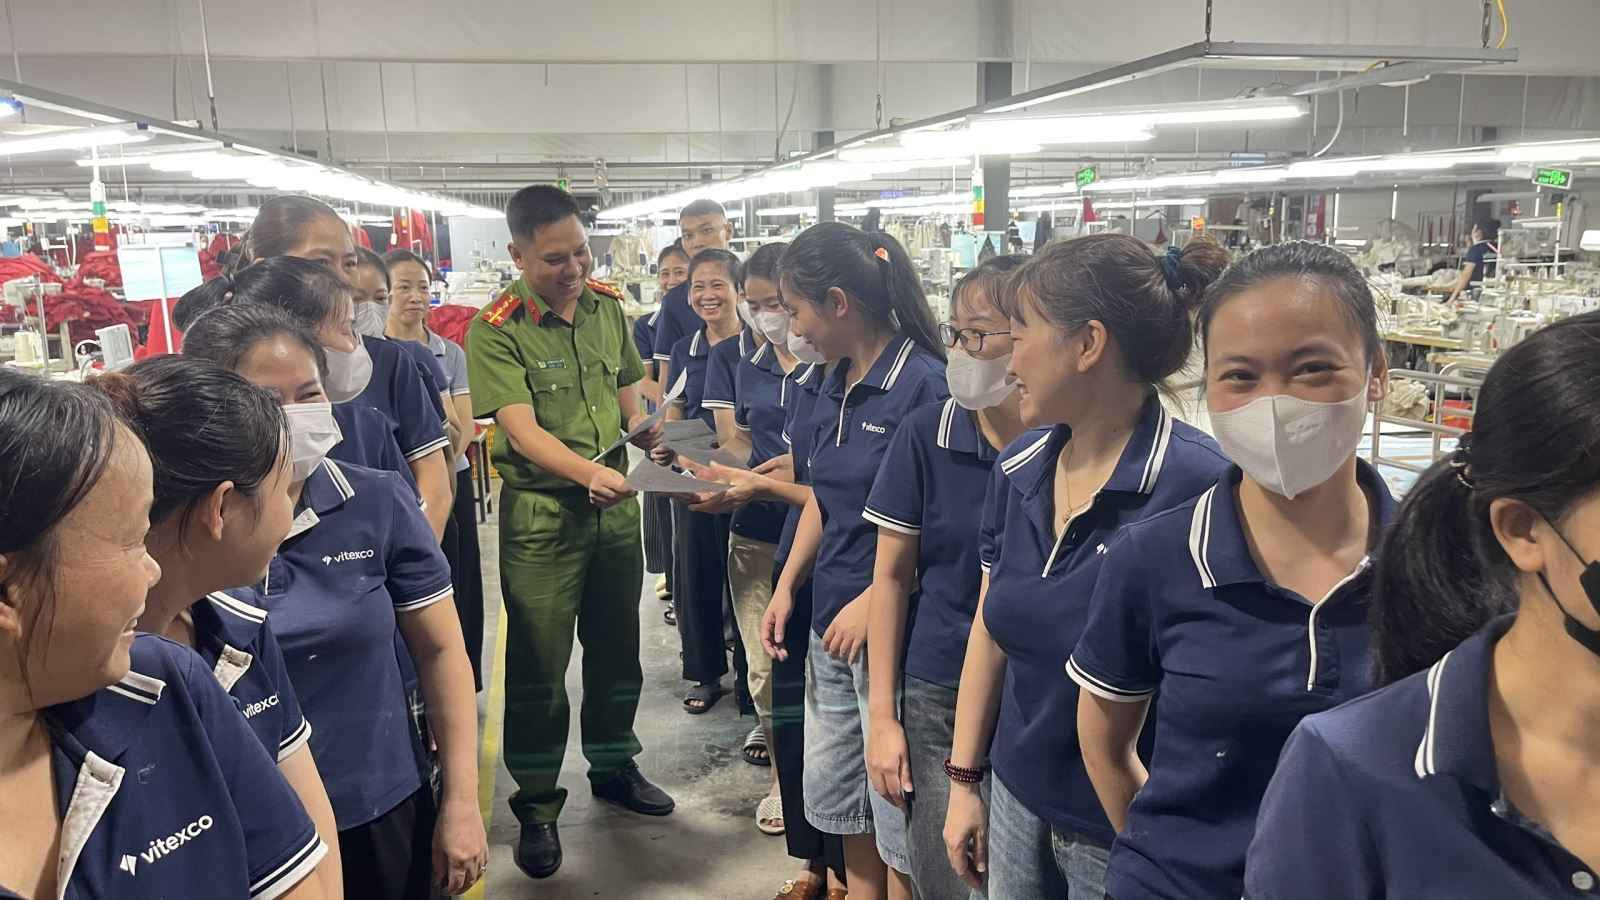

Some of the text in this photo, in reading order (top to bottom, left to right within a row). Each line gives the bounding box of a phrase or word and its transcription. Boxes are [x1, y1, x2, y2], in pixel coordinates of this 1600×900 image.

[334, 549, 375, 563] vitexco
[242, 691, 280, 719] vitexc
[140, 814, 214, 864] vitexco
